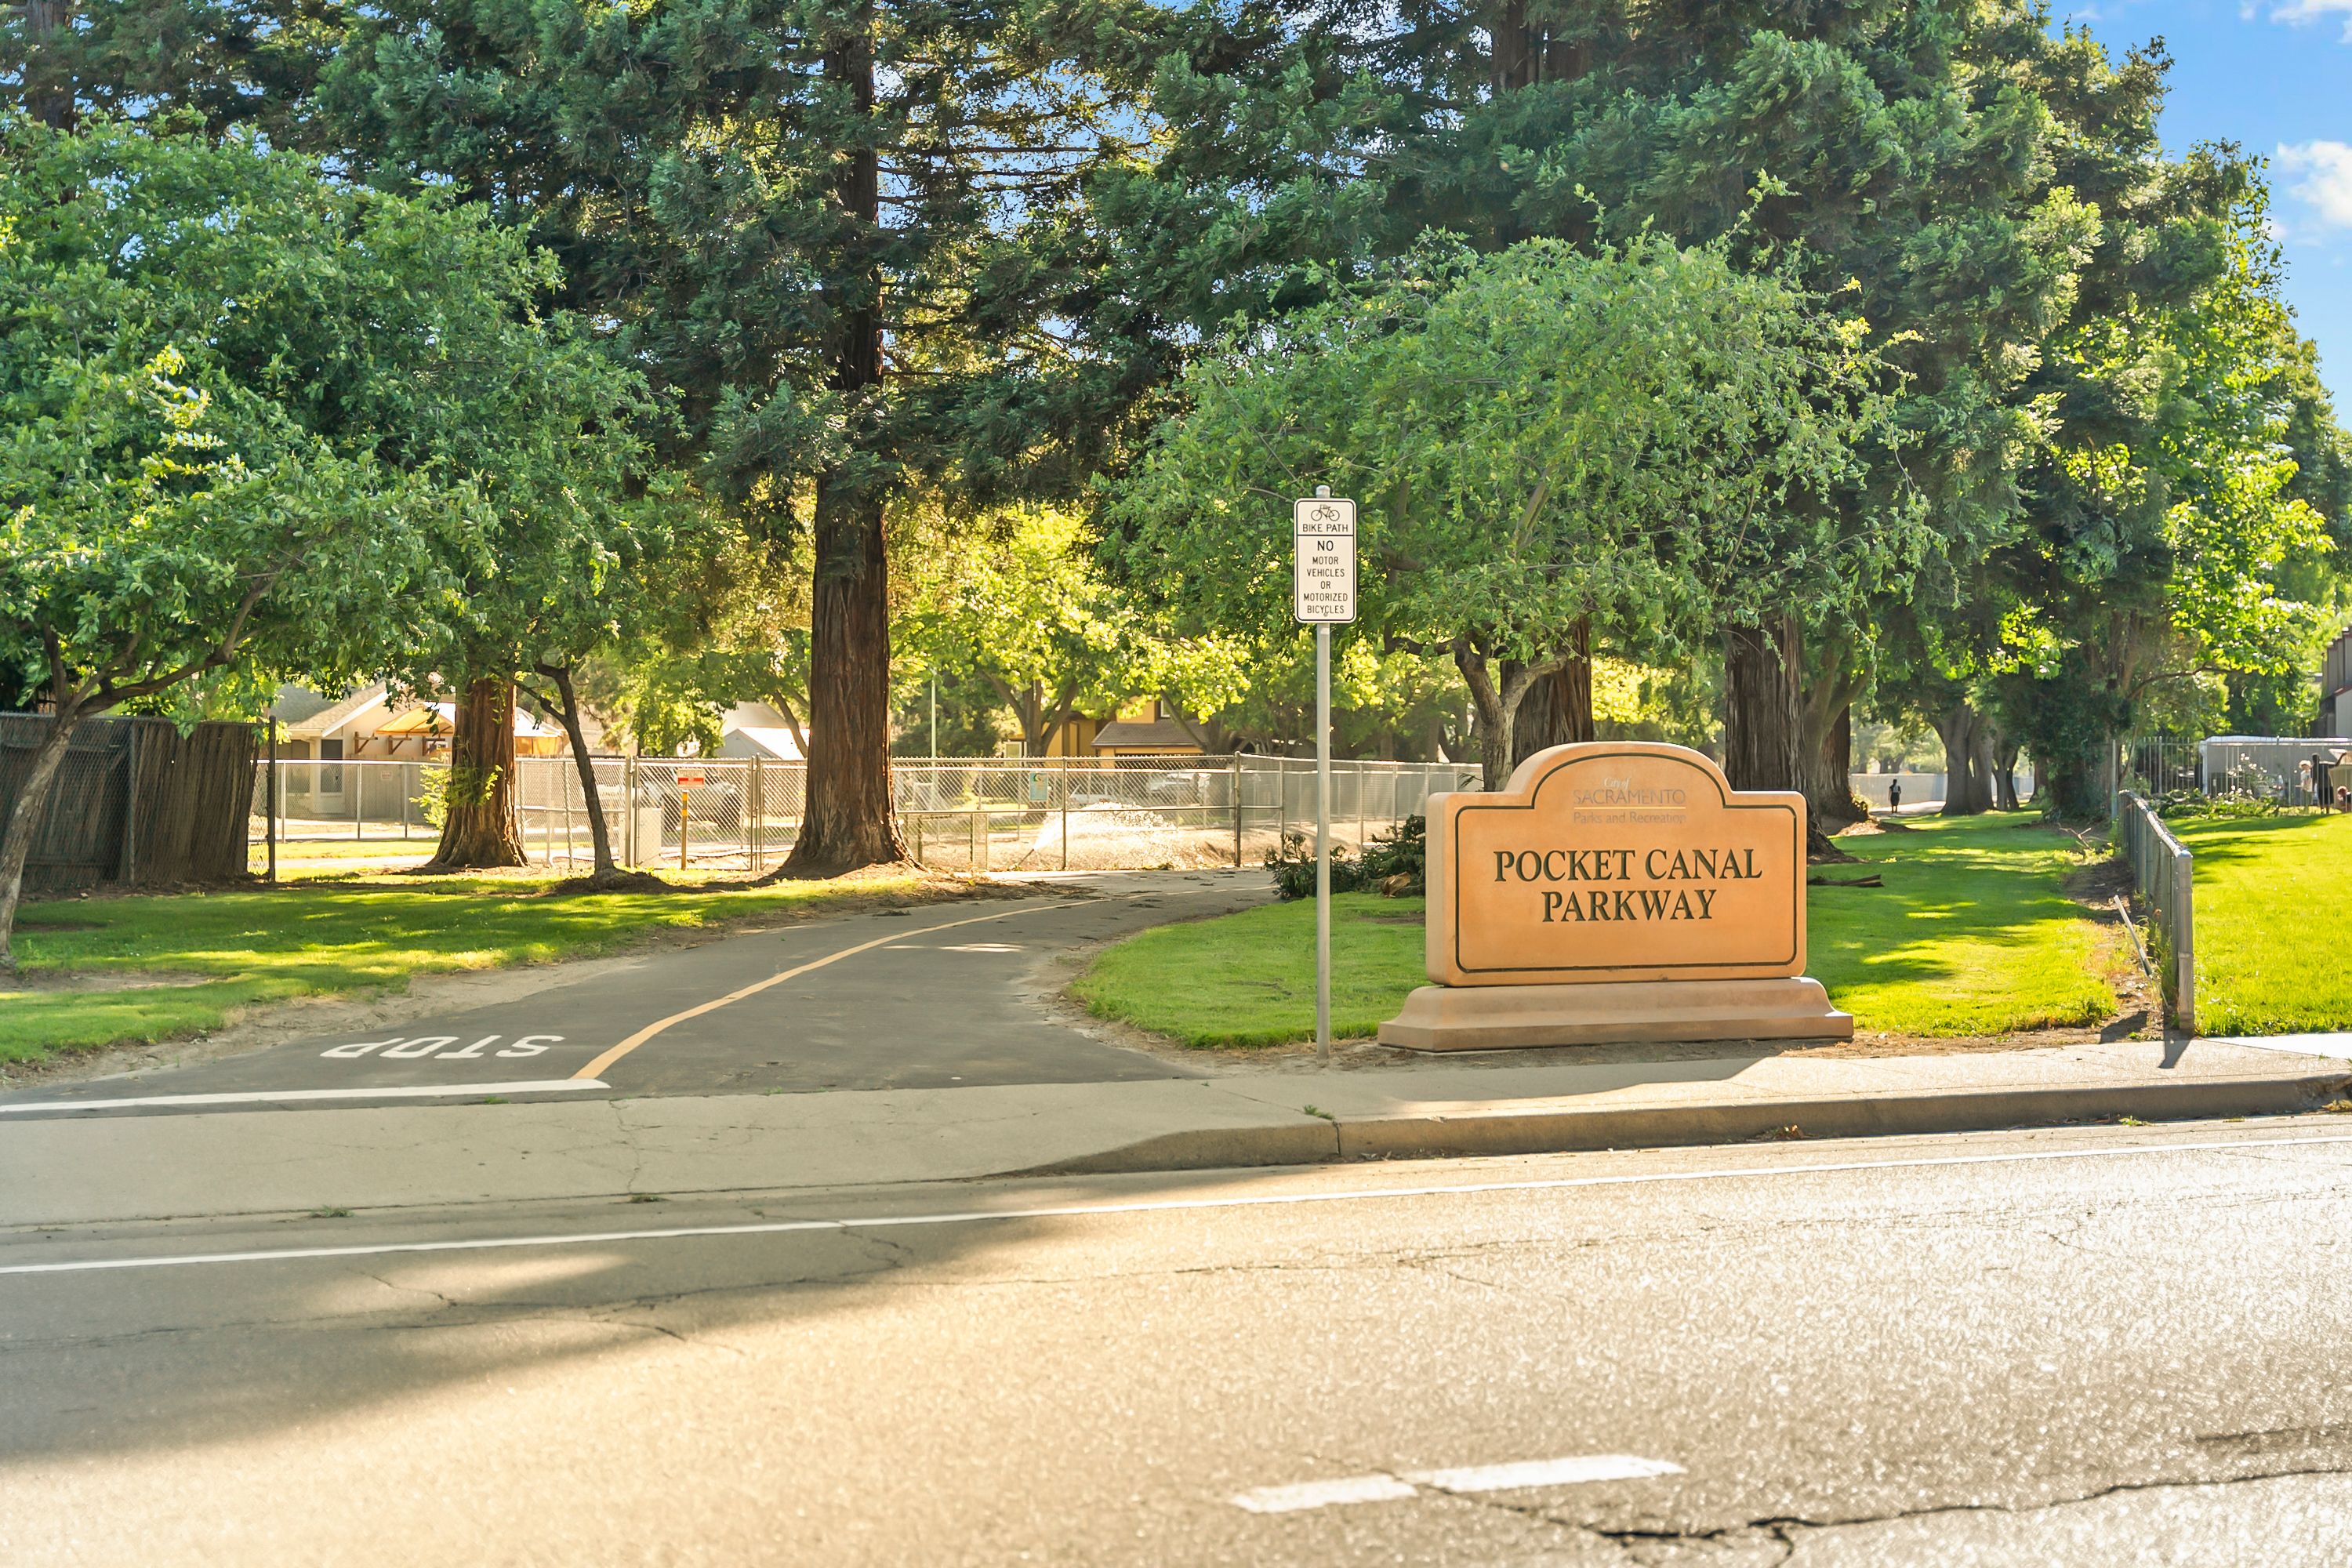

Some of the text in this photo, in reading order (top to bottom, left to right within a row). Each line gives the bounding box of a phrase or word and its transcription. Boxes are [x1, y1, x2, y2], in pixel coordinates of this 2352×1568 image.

[1302, 524, 1348, 532] BIKE PATH
[1317, 540, 1334, 551] NO
[1312, 556, 1339, 565] MOTOR
[1306, 568, 1345, 577] VEHICLES
[1320, 580, 1331, 590] OR
[1303, 593, 1348, 601] MOTORIZED
[1307, 605, 1345, 614] BICYCLES
[1604, 777, 1632, 789] City of
[1573, 789, 1686, 804] SACRAMENTO
[1573, 811, 1686, 823] Parks and Recreation
[1494, 848, 1762, 882] POCKET CANAL
[1541, 889, 1717, 923] PARKWAY
[320, 1035, 566, 1058] STOP
